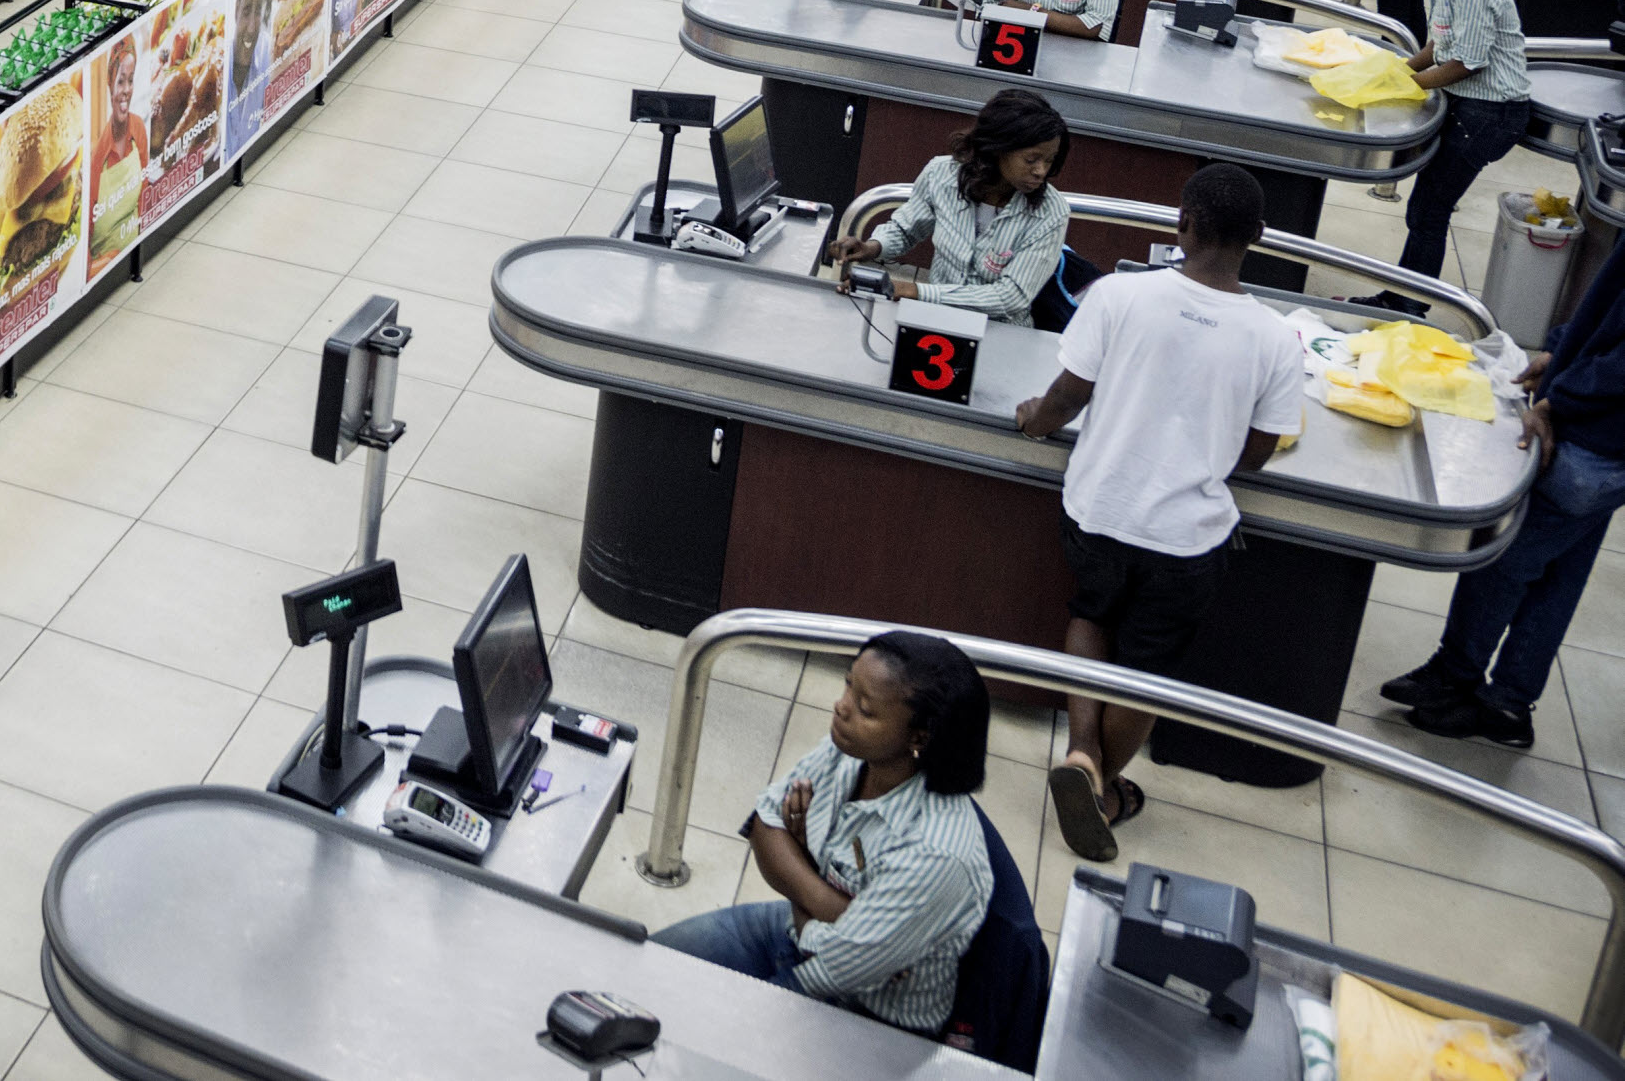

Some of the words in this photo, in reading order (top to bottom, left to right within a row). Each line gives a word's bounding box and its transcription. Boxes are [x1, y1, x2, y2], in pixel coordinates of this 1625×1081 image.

[992, 24, 1026, 66] 5
[265, 53, 311, 109] Premier
[164, 138, 181, 162] bem
[141, 147, 204, 214] Premier
[142, 178, 194, 228] SUPERSPAR
[12, 275, 30, 297] mas
[31, 254, 51, 277] mais
[911, 334, 956, 390] 3
